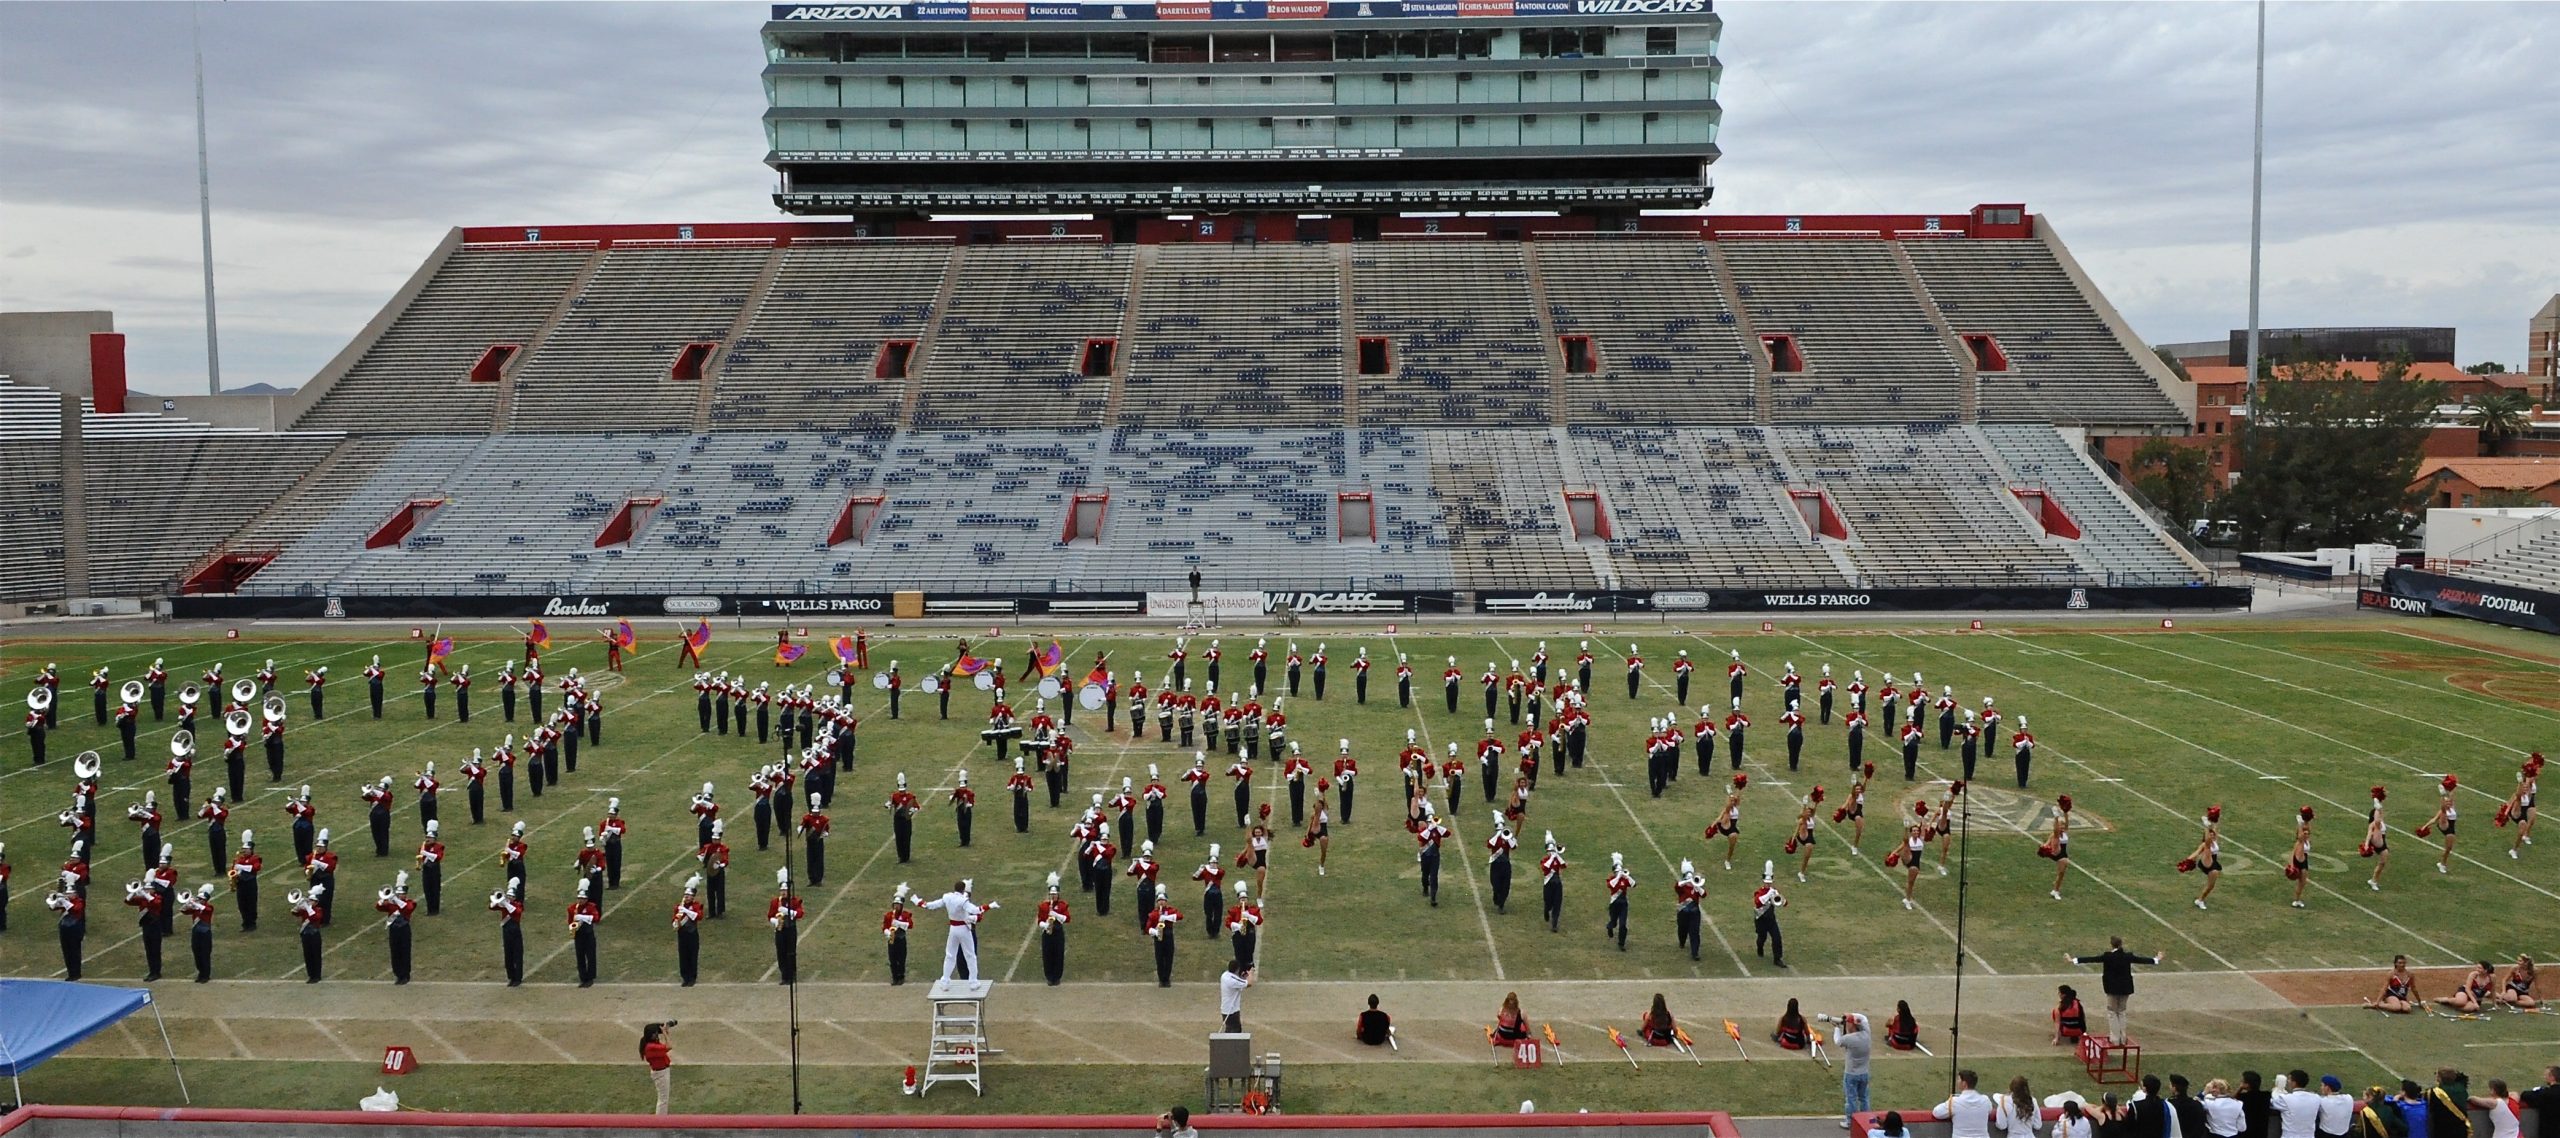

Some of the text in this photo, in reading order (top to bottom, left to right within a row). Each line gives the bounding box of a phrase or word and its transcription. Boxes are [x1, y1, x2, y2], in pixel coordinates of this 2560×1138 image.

[918, 6, 967, 15] 22 ART LUPPINO
[1577, 0, 1705, 12] WILDCATS
[785, 5, 902, 20] ARIZONA
[1052, 226, 1065, 236] 20
[1202, 225, 1213, 234] 21
[1426, 224, 1438, 232] 22
[1625, 223, 1638, 231] 23
[1787, 222, 1800, 231] 24
[1926, 222, 1940, 230] 25
[528, 232, 538, 242] 17
[681, 230, 692, 240] 18
[855, 228, 866, 237] 19
[164, 401, 174, 410] 16
[775, 600, 882, 610] WELLS FARGO
[1150, 598, 1186, 609] UNIVERSITY
[1226, 598, 1246, 609] BAND
[1247, 598, 1260, 609] DAY
[1765, 595, 1870, 606] WELLS FARGO
[2361, 591, 2426, 614] BEAR DOWN
[2437, 588, 2536, 616] ARIZONA FOOTBALL
[544, 597, 610, 616] Bashas'
[1518, 1043, 1538, 1064] 40
[385, 1050, 405, 1071] 40
